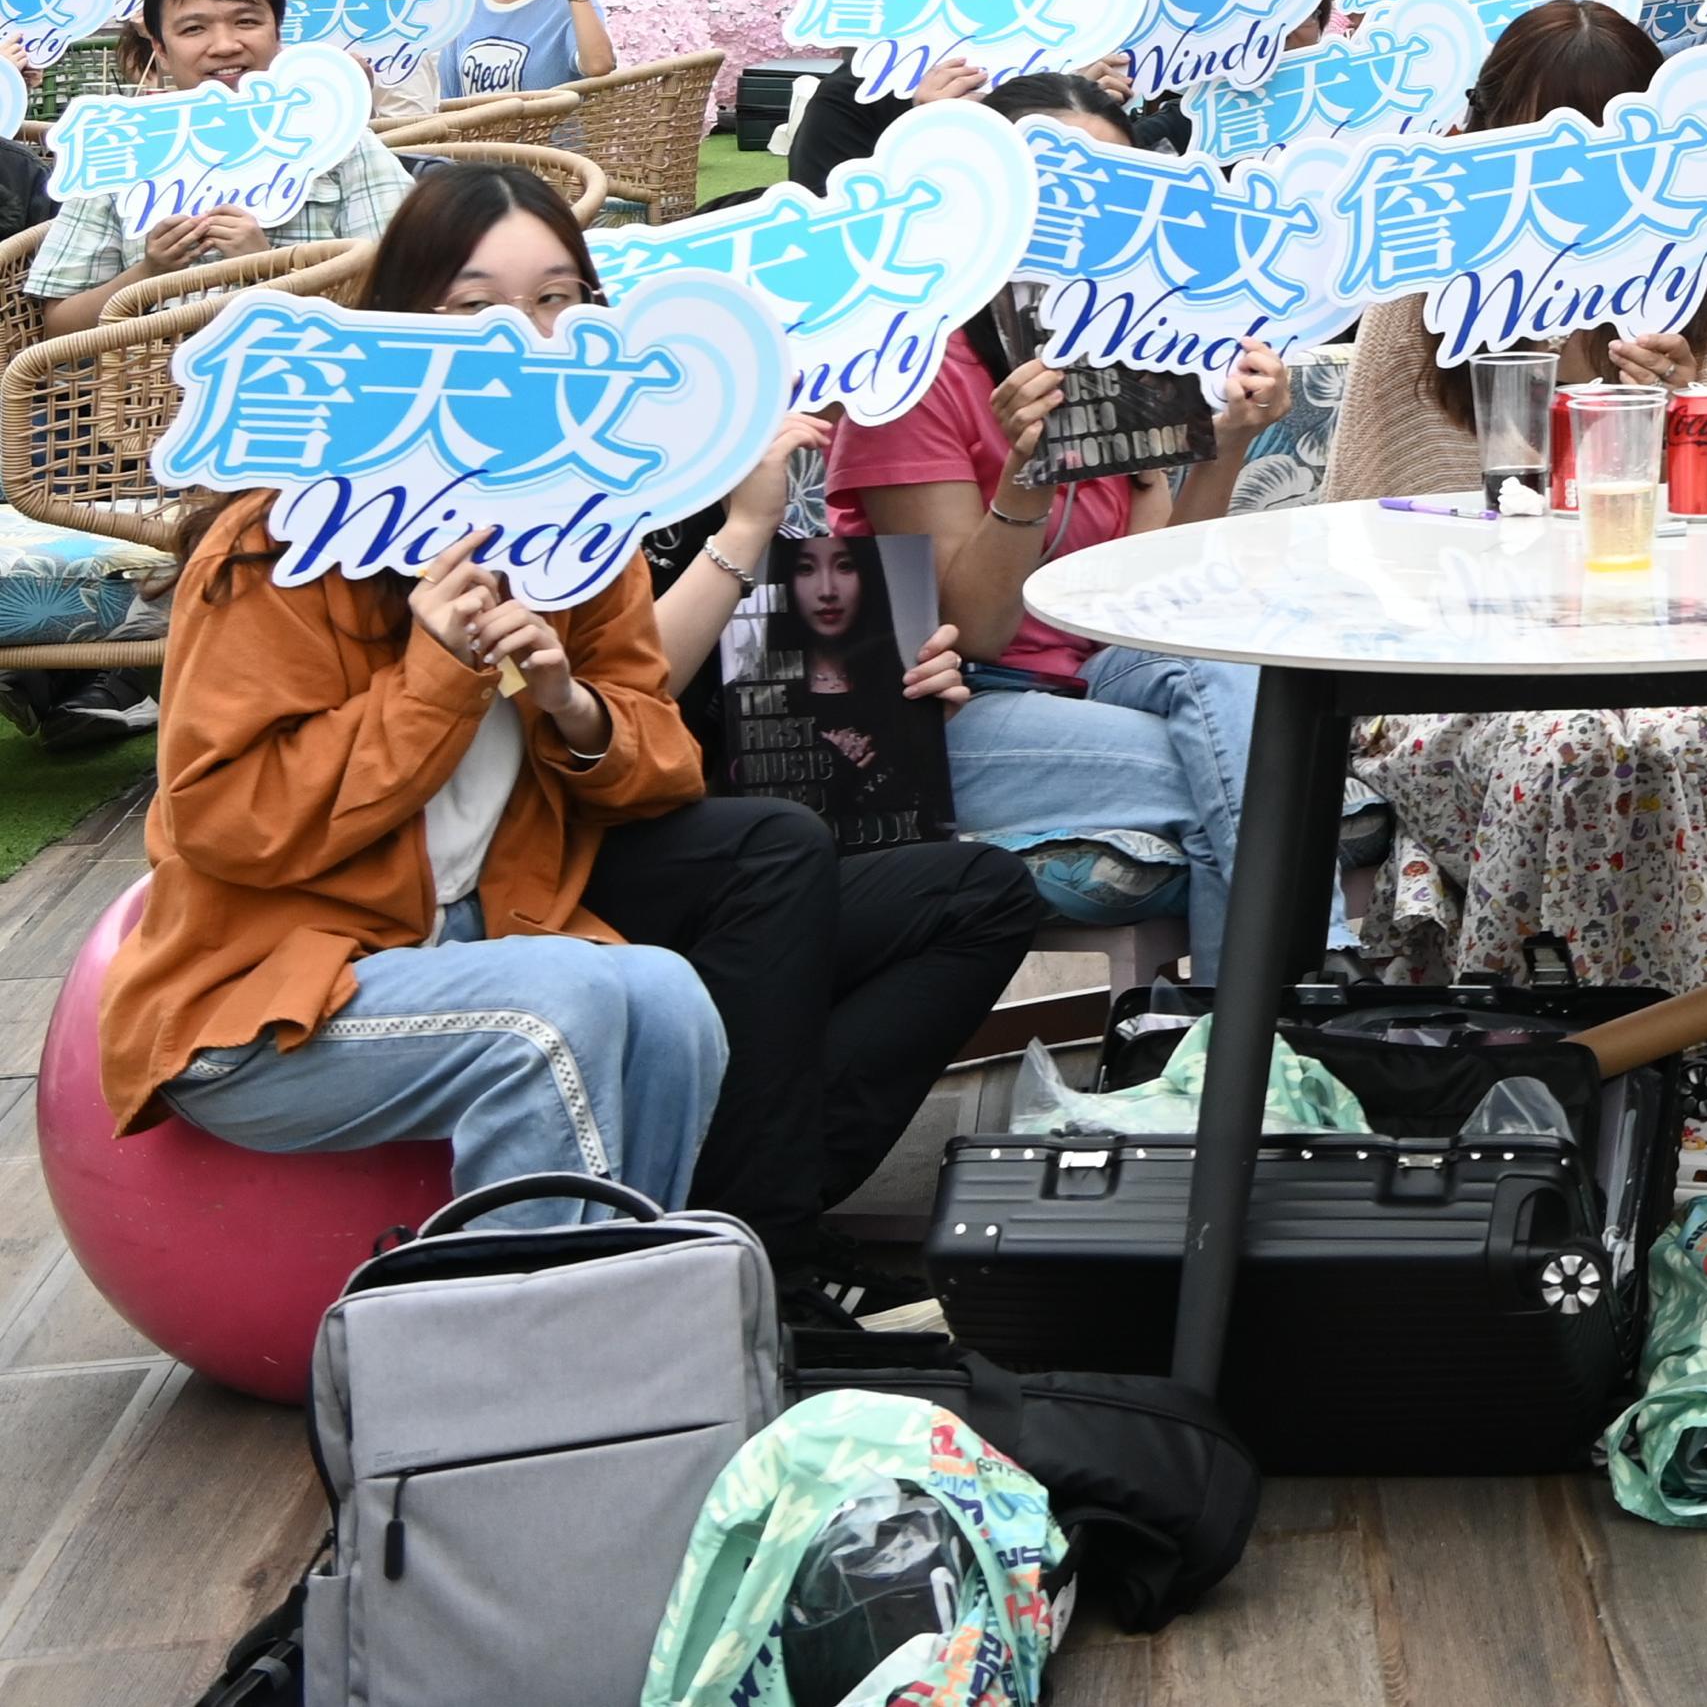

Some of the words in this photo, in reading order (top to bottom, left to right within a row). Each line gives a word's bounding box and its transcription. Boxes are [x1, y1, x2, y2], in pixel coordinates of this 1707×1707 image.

[1124, 17, 1288, 99] Windy
[1202, 31, 1437, 160] 詹天文
[62, 89, 314, 189] 詹天文
[124, 162, 316, 235] Windy
[1338, 117, 1706, 287] 詹天文
[168, 316, 680, 486] 詹天文
[1064, 366, 1121, 403] USIC
[1131, 424, 1190, 460] BOOK
[287, 468, 653, 599] Windy
[735, 684, 789, 716] THE
[742, 716, 816, 750] FIRST
[744, 750, 834, 783] MUSIC
